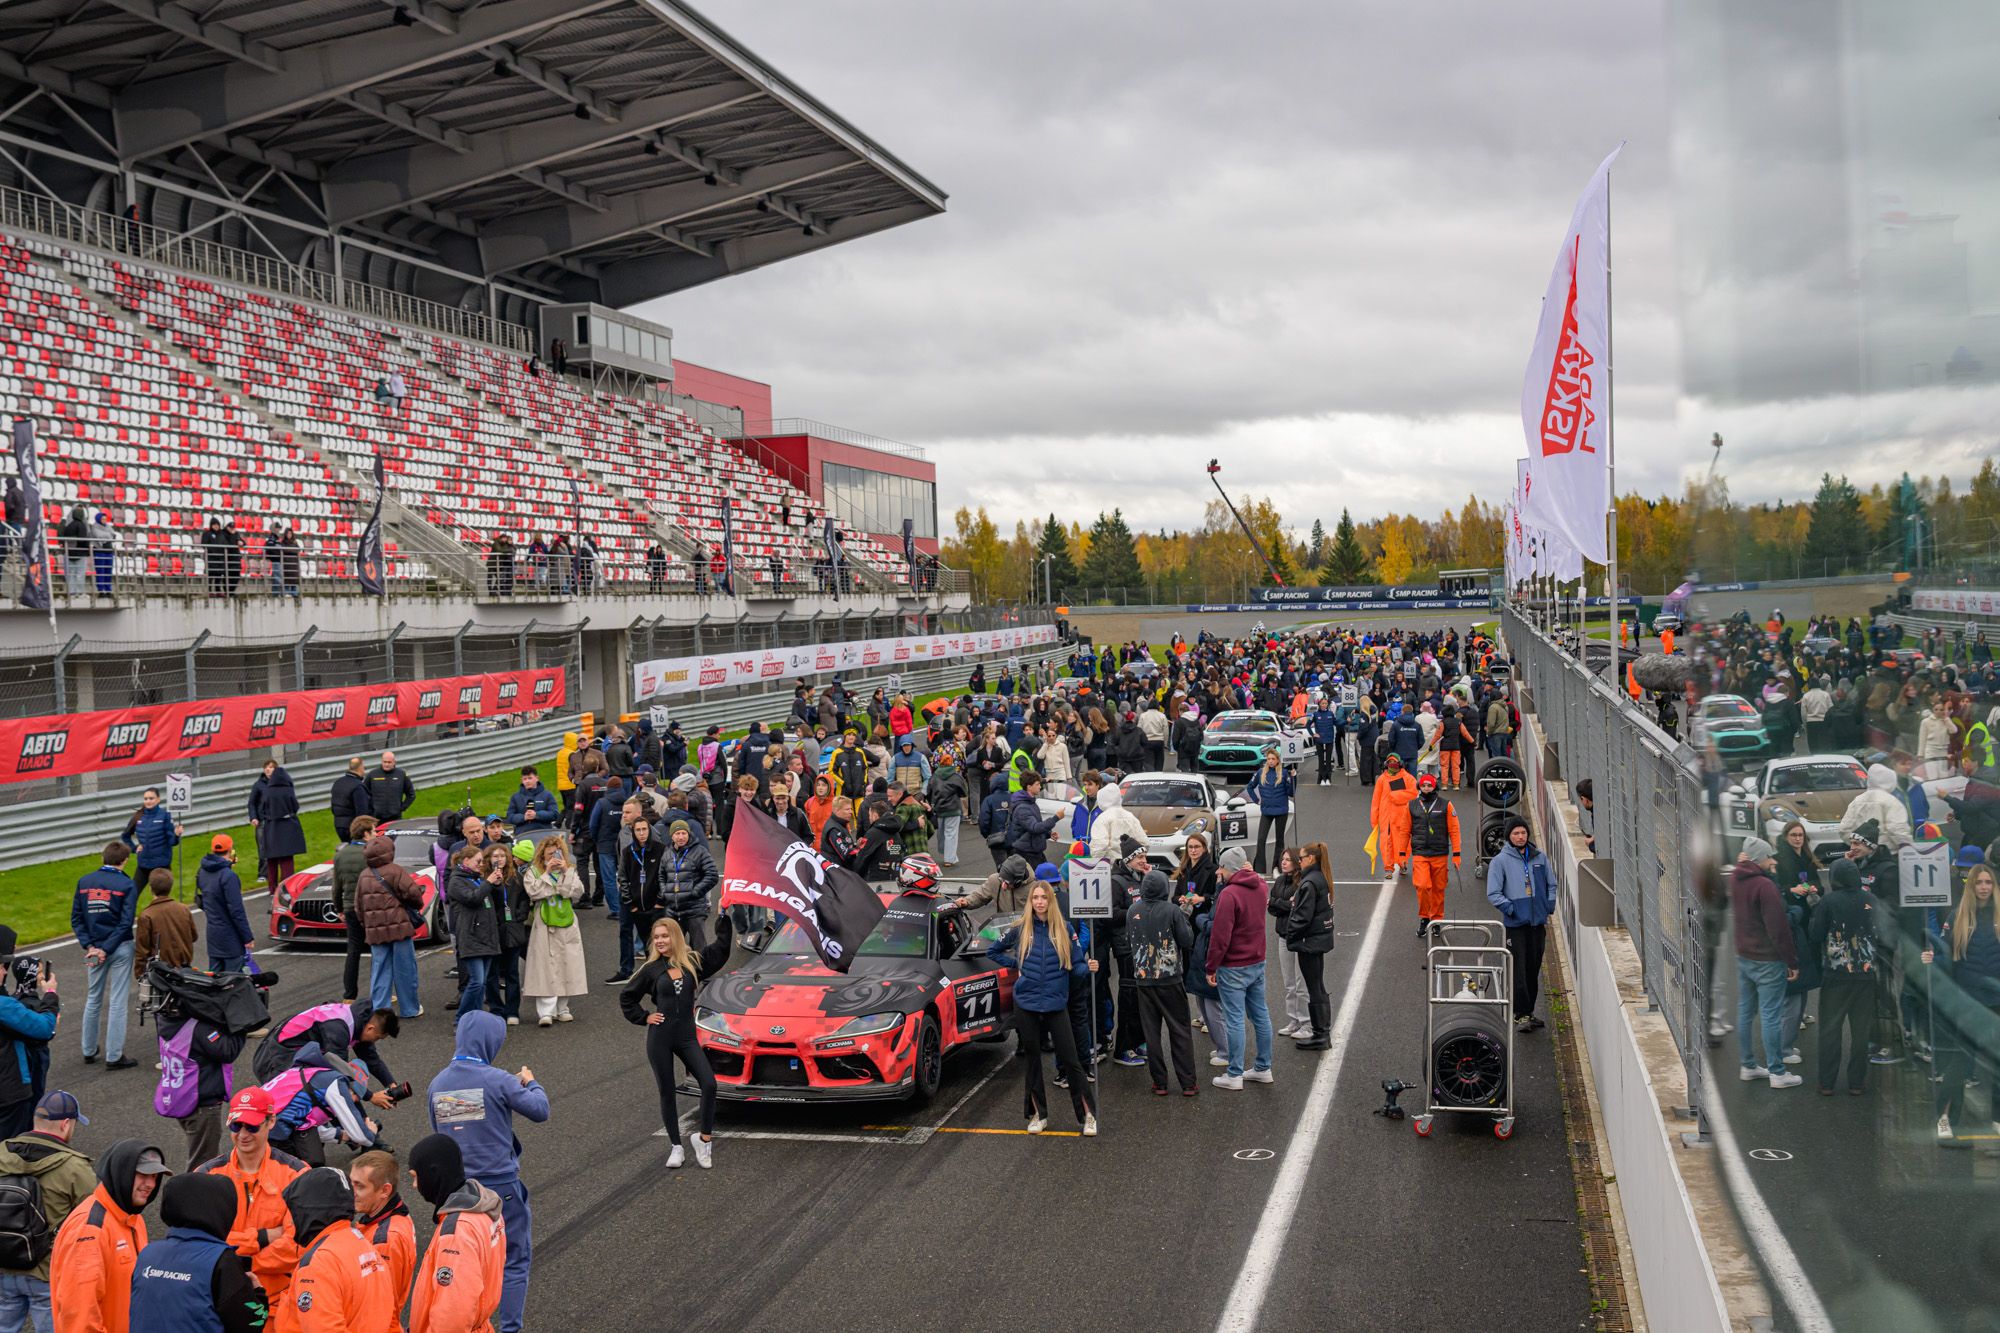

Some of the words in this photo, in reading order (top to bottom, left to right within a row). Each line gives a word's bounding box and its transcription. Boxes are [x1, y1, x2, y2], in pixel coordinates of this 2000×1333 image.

[1411, 589, 1438, 597] RACING
[734, 660, 753, 674] TMS
[499, 683, 518, 698] АВТО
[534, 679, 553, 694] АВТО
[420, 693, 441, 708] АВТО
[460, 688, 481, 702] АВТО
[1344, 692, 1354, 701] 88
[316, 702, 345, 720] АВТО
[368, 697, 395, 714] АВТО
[253, 708, 286, 727] АВТО
[655, 714, 665, 723] 16
[182, 715, 222, 736] АВТО
[107, 723, 149, 745] АВТО
[22, 732, 67, 756] АВТО
[104, 744, 134, 758] ПЛЮС
[1288, 742, 1295, 754] 8
[19, 756, 51, 770] ПЛЮС
[172, 788, 186, 802] 63
[1229, 821, 1239, 834] 8
[1079, 878, 1100, 900] 11
[956, 978, 996, 995] G-ENERGY
[963, 992, 993, 1018] 11
[969, 1020, 978, 1028] SMP
[979, 1016, 996, 1025] RACING
[718, 1037, 739, 1047] YOKOHAMA
[826, 1040, 853, 1048] YOKOHAMA
[149, 1268, 164, 1277] SMP
[164, 1270, 191, 1282] RACING
